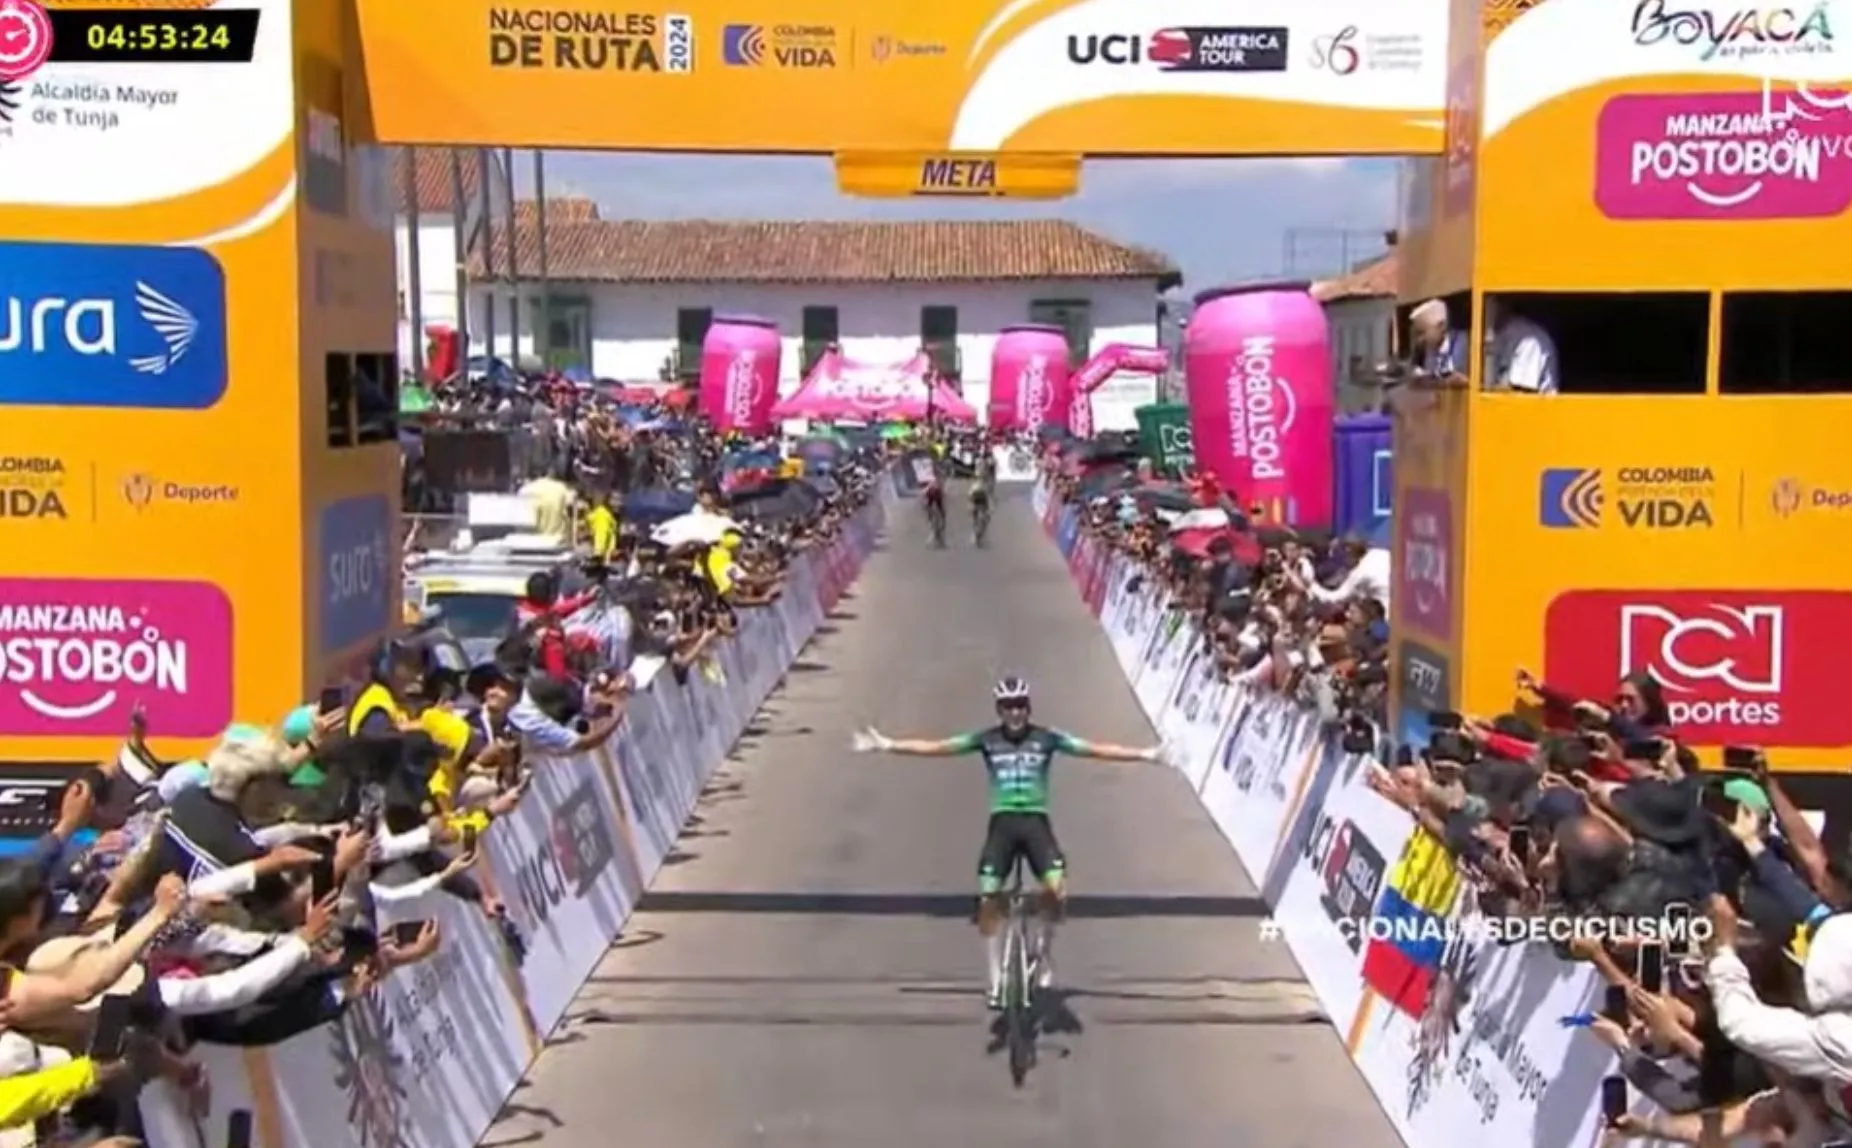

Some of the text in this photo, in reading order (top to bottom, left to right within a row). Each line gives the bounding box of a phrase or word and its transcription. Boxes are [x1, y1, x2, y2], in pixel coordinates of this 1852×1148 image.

[490, 9, 656, 35] NACIONALES
[490, 36, 659, 72] DE RUTA
[669, 18, 688, 70] 2024
[1067, 34, 1141, 64] UCI
[1200, 34, 1279, 50] AMERICA
[774, 47, 836, 68] VIDA
[1200, 50, 1246, 65] TOUR
[117, 87, 179, 110] Mayor
[33, 107, 120, 130] de Tunja
[1666, 113, 1769, 138] MANZANA
[918, 158, 996, 189] META
[0, 458, 64, 473] OMBIA
[1617, 467, 1714, 483] COLOMBIA
[163, 482, 239, 503] Deporte
[1812, 488, 1852, 509] Dep
[1616, 500, 1714, 529] VIDA
[0, 605, 125, 632] MANZANA
[0, 627, 187, 694] STOBÓN
[1668, 697, 1781, 728] portes
